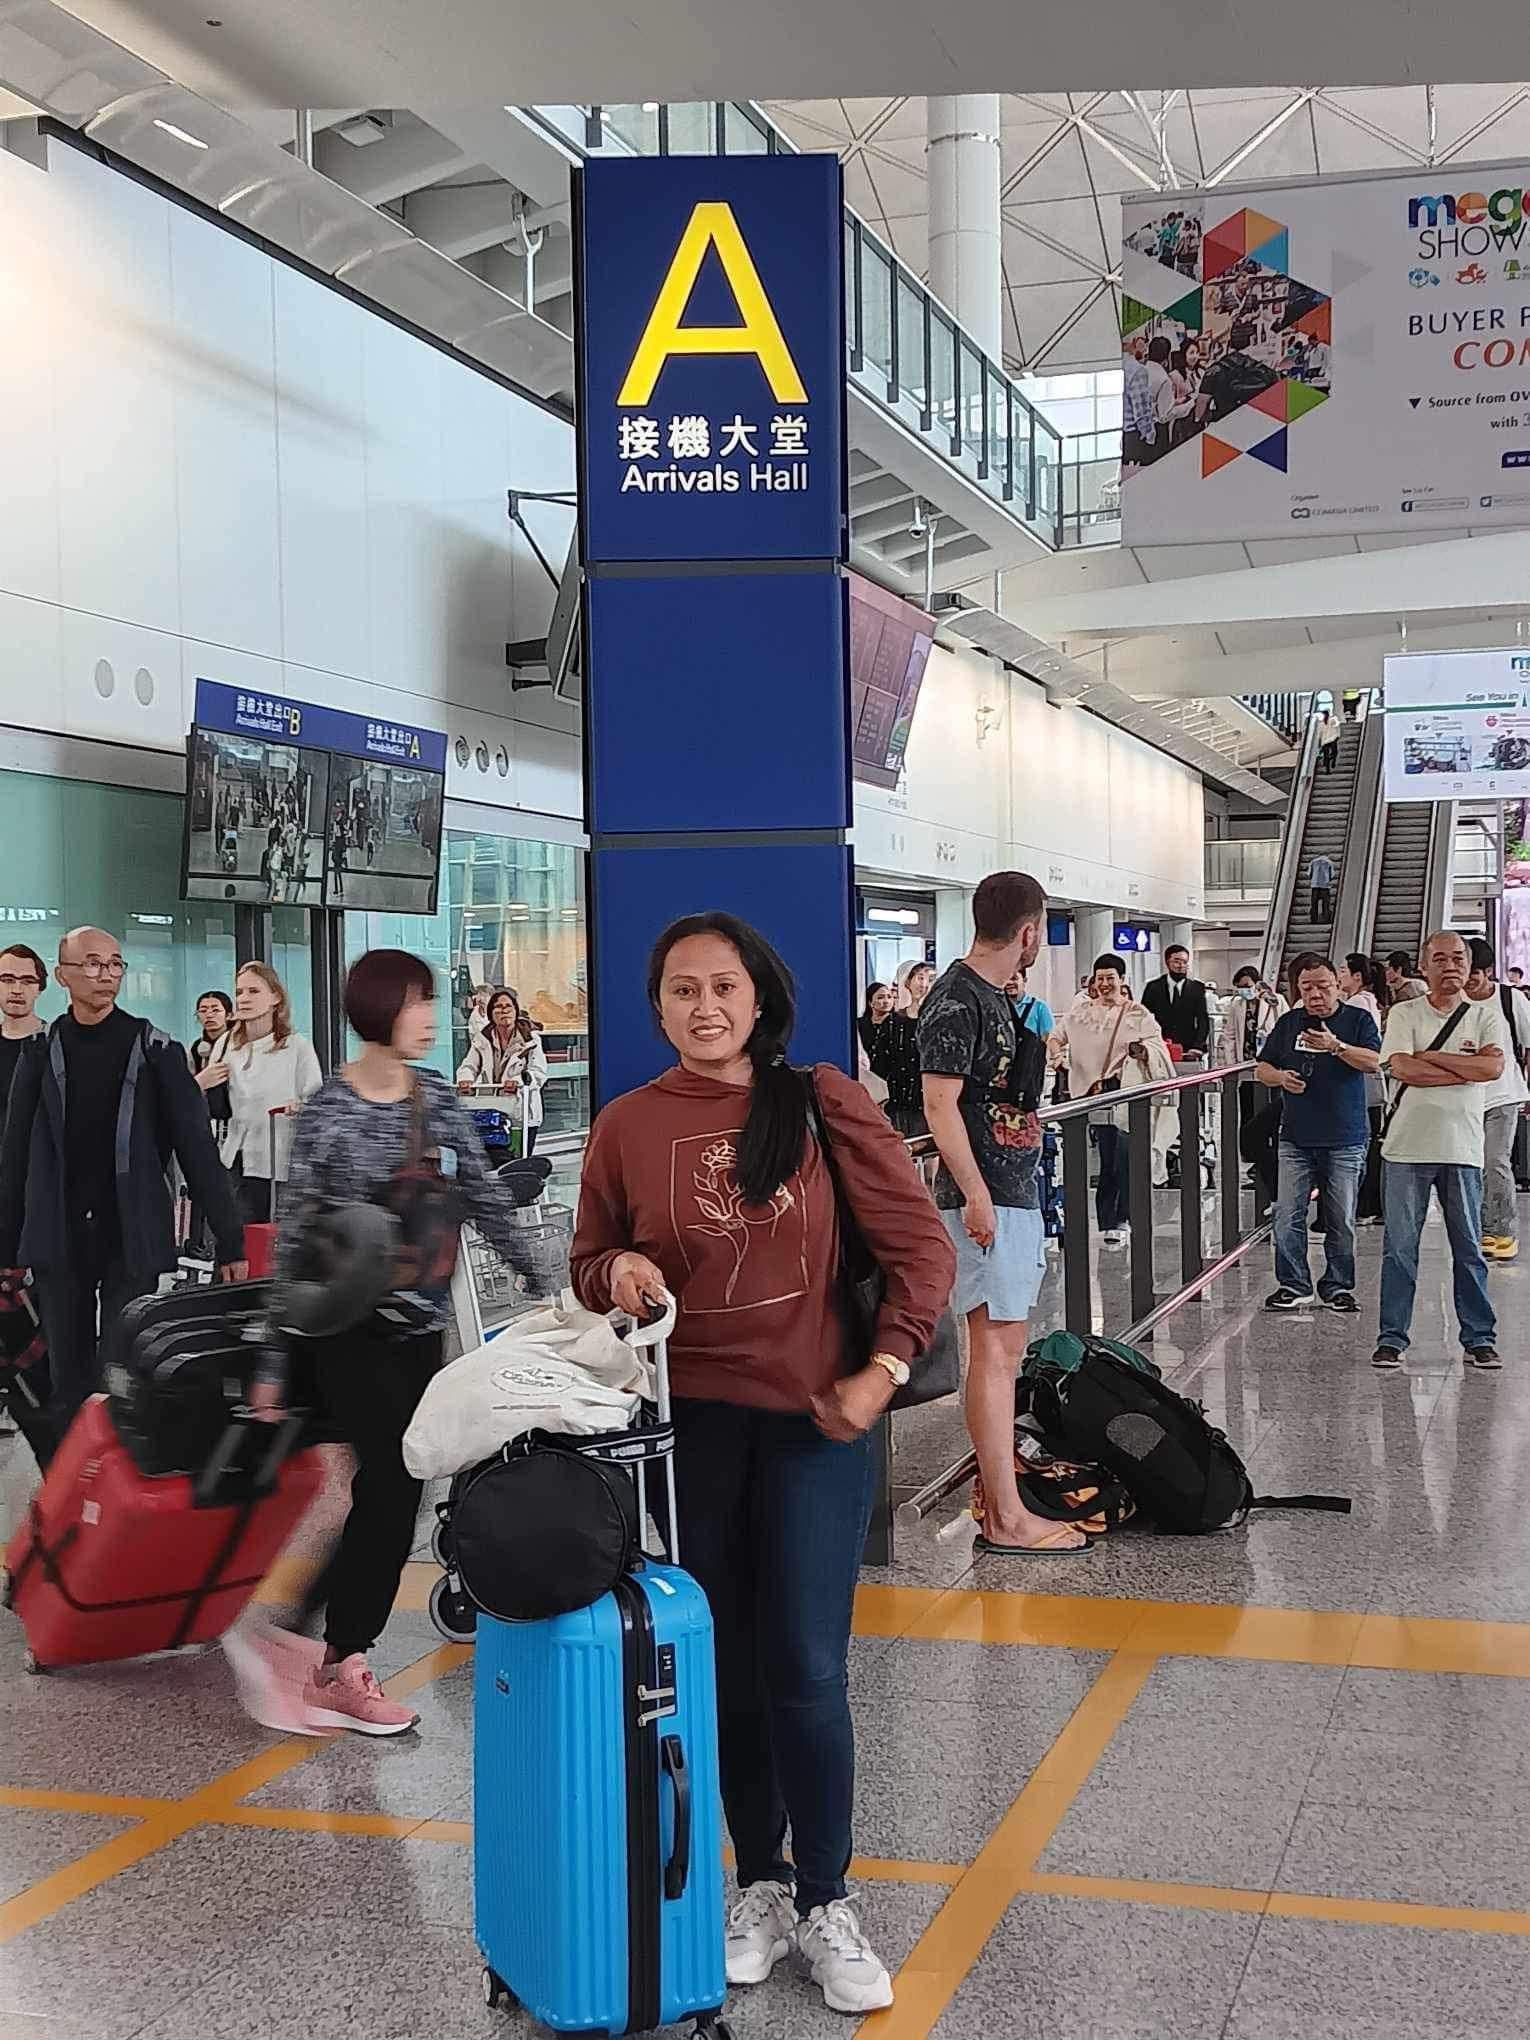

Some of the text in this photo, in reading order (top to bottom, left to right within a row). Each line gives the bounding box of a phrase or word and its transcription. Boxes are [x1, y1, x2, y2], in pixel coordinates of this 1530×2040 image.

[1418, 221, 1528, 260] SHOW
[616, 202, 809, 406] A
[1409, 308, 1505, 336] BUYER
[1429, 397, 1471, 408] Source
[1475, 393, 1505, 405] from
[1490, 415, 1518, 428] with
[618, 414, 809, 459] 接機大堂
[620, 462, 808, 492] Arrivals Hall
[289, 708, 301, 735] B
[409, 735, 421, 760] A
